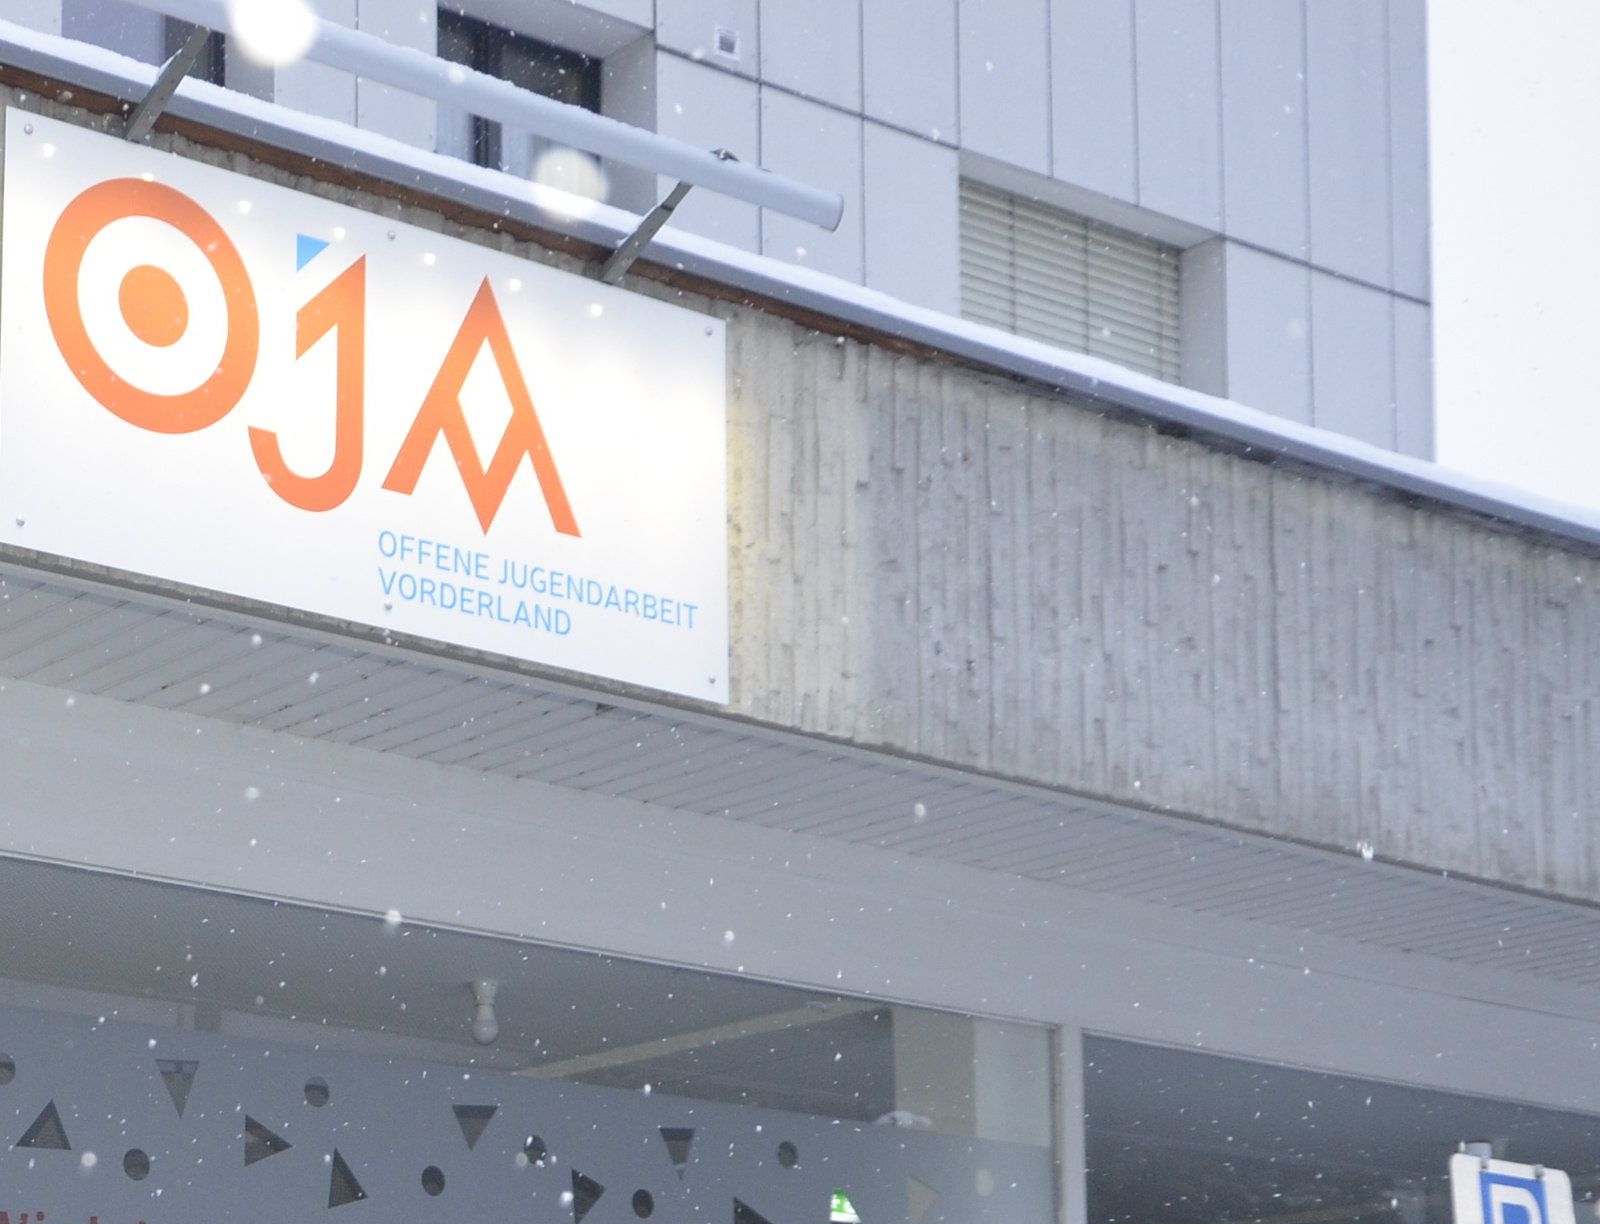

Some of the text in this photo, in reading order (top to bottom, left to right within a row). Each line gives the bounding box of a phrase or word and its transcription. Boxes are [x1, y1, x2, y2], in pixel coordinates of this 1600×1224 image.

[378, 530, 698, 629] OFFENE JUGENDARBEIT
[378, 566, 572, 636] VORDERLAND
